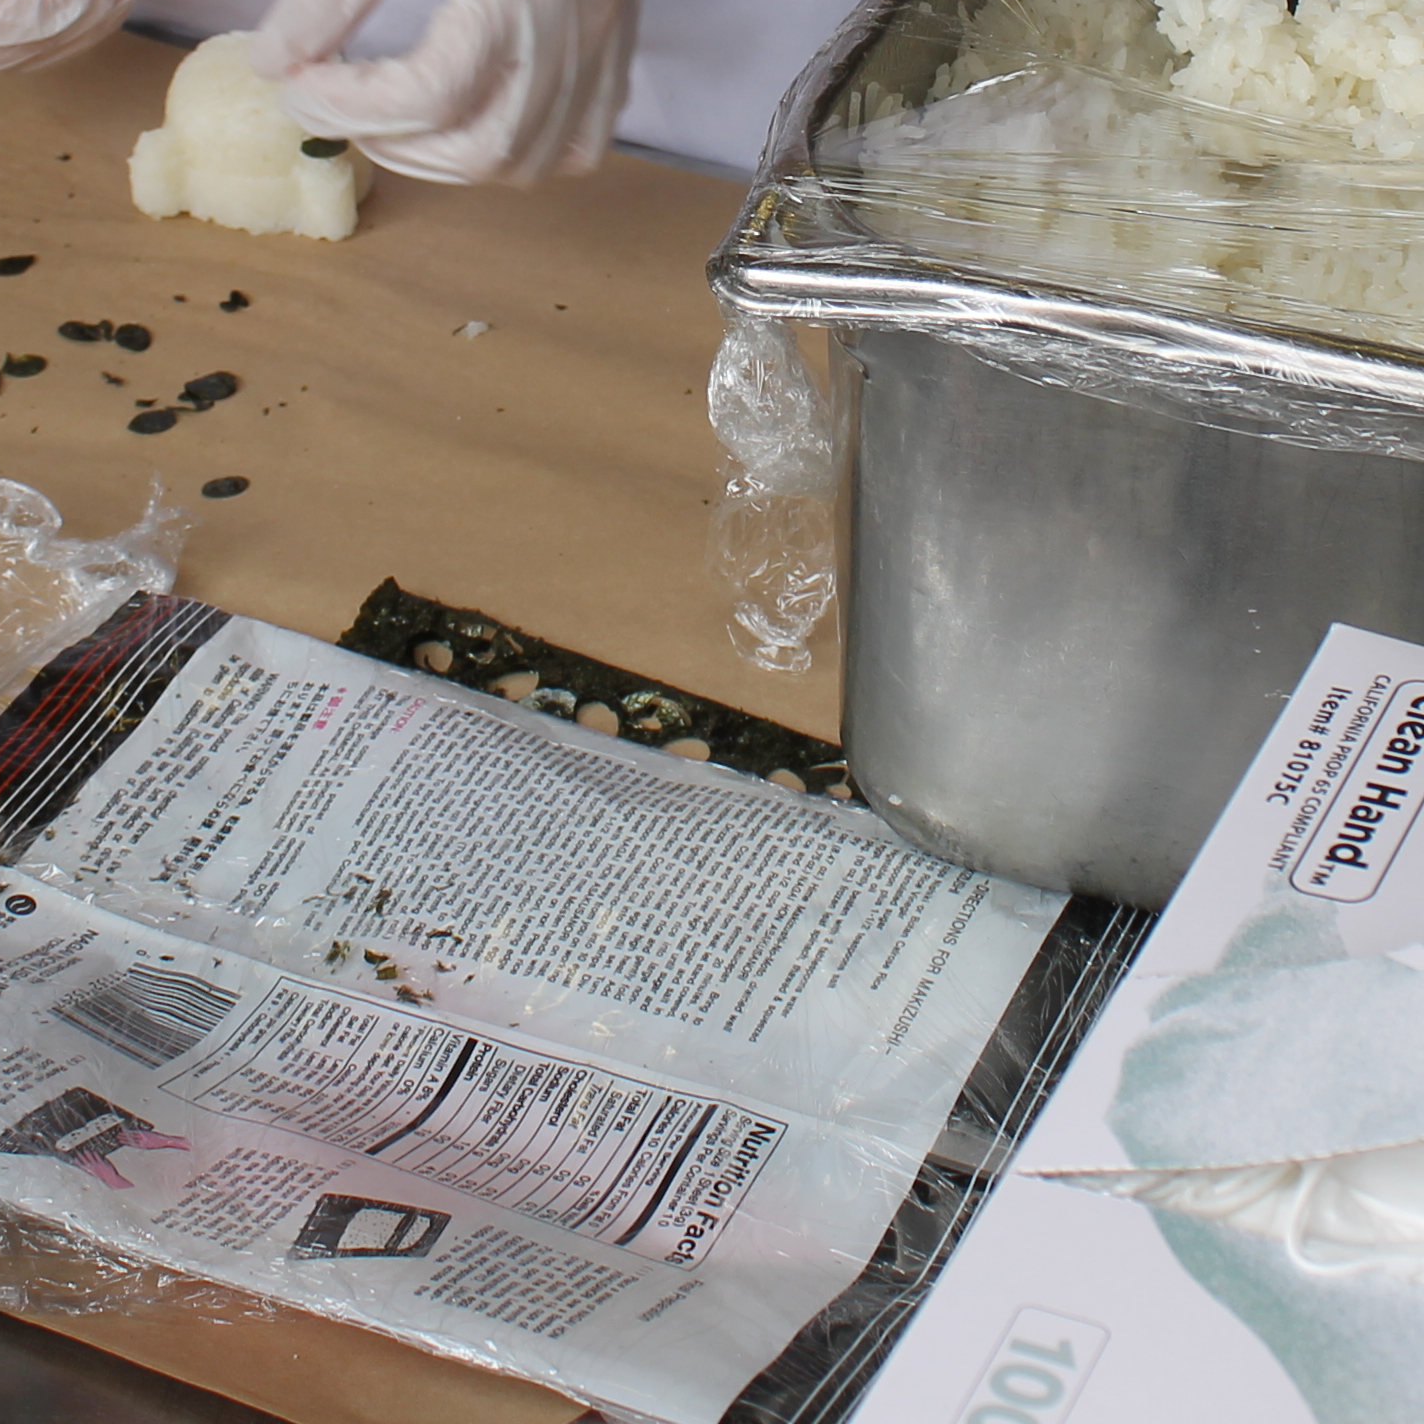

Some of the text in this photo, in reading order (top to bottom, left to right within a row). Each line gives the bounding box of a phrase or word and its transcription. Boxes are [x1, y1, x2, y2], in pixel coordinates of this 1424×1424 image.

[1264, 681, 1353, 810] Item# 81075C
[1267, 671, 1392, 873] CALIFORNIA PROP 65 COMPLIANT
[772, 900, 791, 923] HON
[872, 888, 890, 908] plus
[827, 917, 844, 938] with
[873, 906, 894, 931] sugar
[823, 937, 833, 945] 2
[925, 947, 950, 976] FOR
[869, 970, 887, 992] Rice
[732, 979, 760, 1015] drained
[779, 994, 798, 1018] water
[722, 1013, 739, 1033] well
[746, 1001, 777, 1044] squeezed
[411, 1024, 445, 1071] Calcium
[431, 1029, 464, 1075] Vitamin
[460, 1041, 492, 1083] Protein
[476, 1055, 508, 1095] Sugars
[526, 1059, 550, 1089] Total
[395, 1075, 415, 1099] 0%
[425, 1072, 440, 1086] A
[495, 1061, 526, 1100] Dietary
[537, 1063, 569, 1105] Sodium
[414, 1082, 434, 1105] 8%
[545, 1067, 589, 1129] Cholesterol
[624, 1086, 648, 1116] Total
[480, 1098, 503, 1126] Fiber
[484, 1084, 534, 1150] Carbohydrate
[586, 1089, 622, 1139] Saturated
[612, 1113, 631, 1135] Fat
[654, 1096, 687, 1137] Calories
[531, 1081, 604, 1179] Trans Fat 0g
[647, 1134, 662, 1150] 10
[450, 1139, 471, 1153] 1g
[471, 1145, 491, 1160] 1g
[575, 1136, 594, 1157] Fat
[643, 1101, 703, 1188] Amount Per Serving
[485, 1149, 511, 1171] 0mg
[506, 1155, 531, 1176] 0mg
[621, 1149, 653, 1191] Calories
[656, 1106, 737, 1229] Servings Per Container 10
[670, 1112, 752, 1230] Serving Size 1 Sheet (3g)
[551, 1166, 572, 1185] 0g
[572, 1172, 592, 1190] 0g
[605, 1187, 628, 1214] From
[663, 1117, 777, 1271] Nutrition Facts
[593, 1209, 612, 1227] Fat
